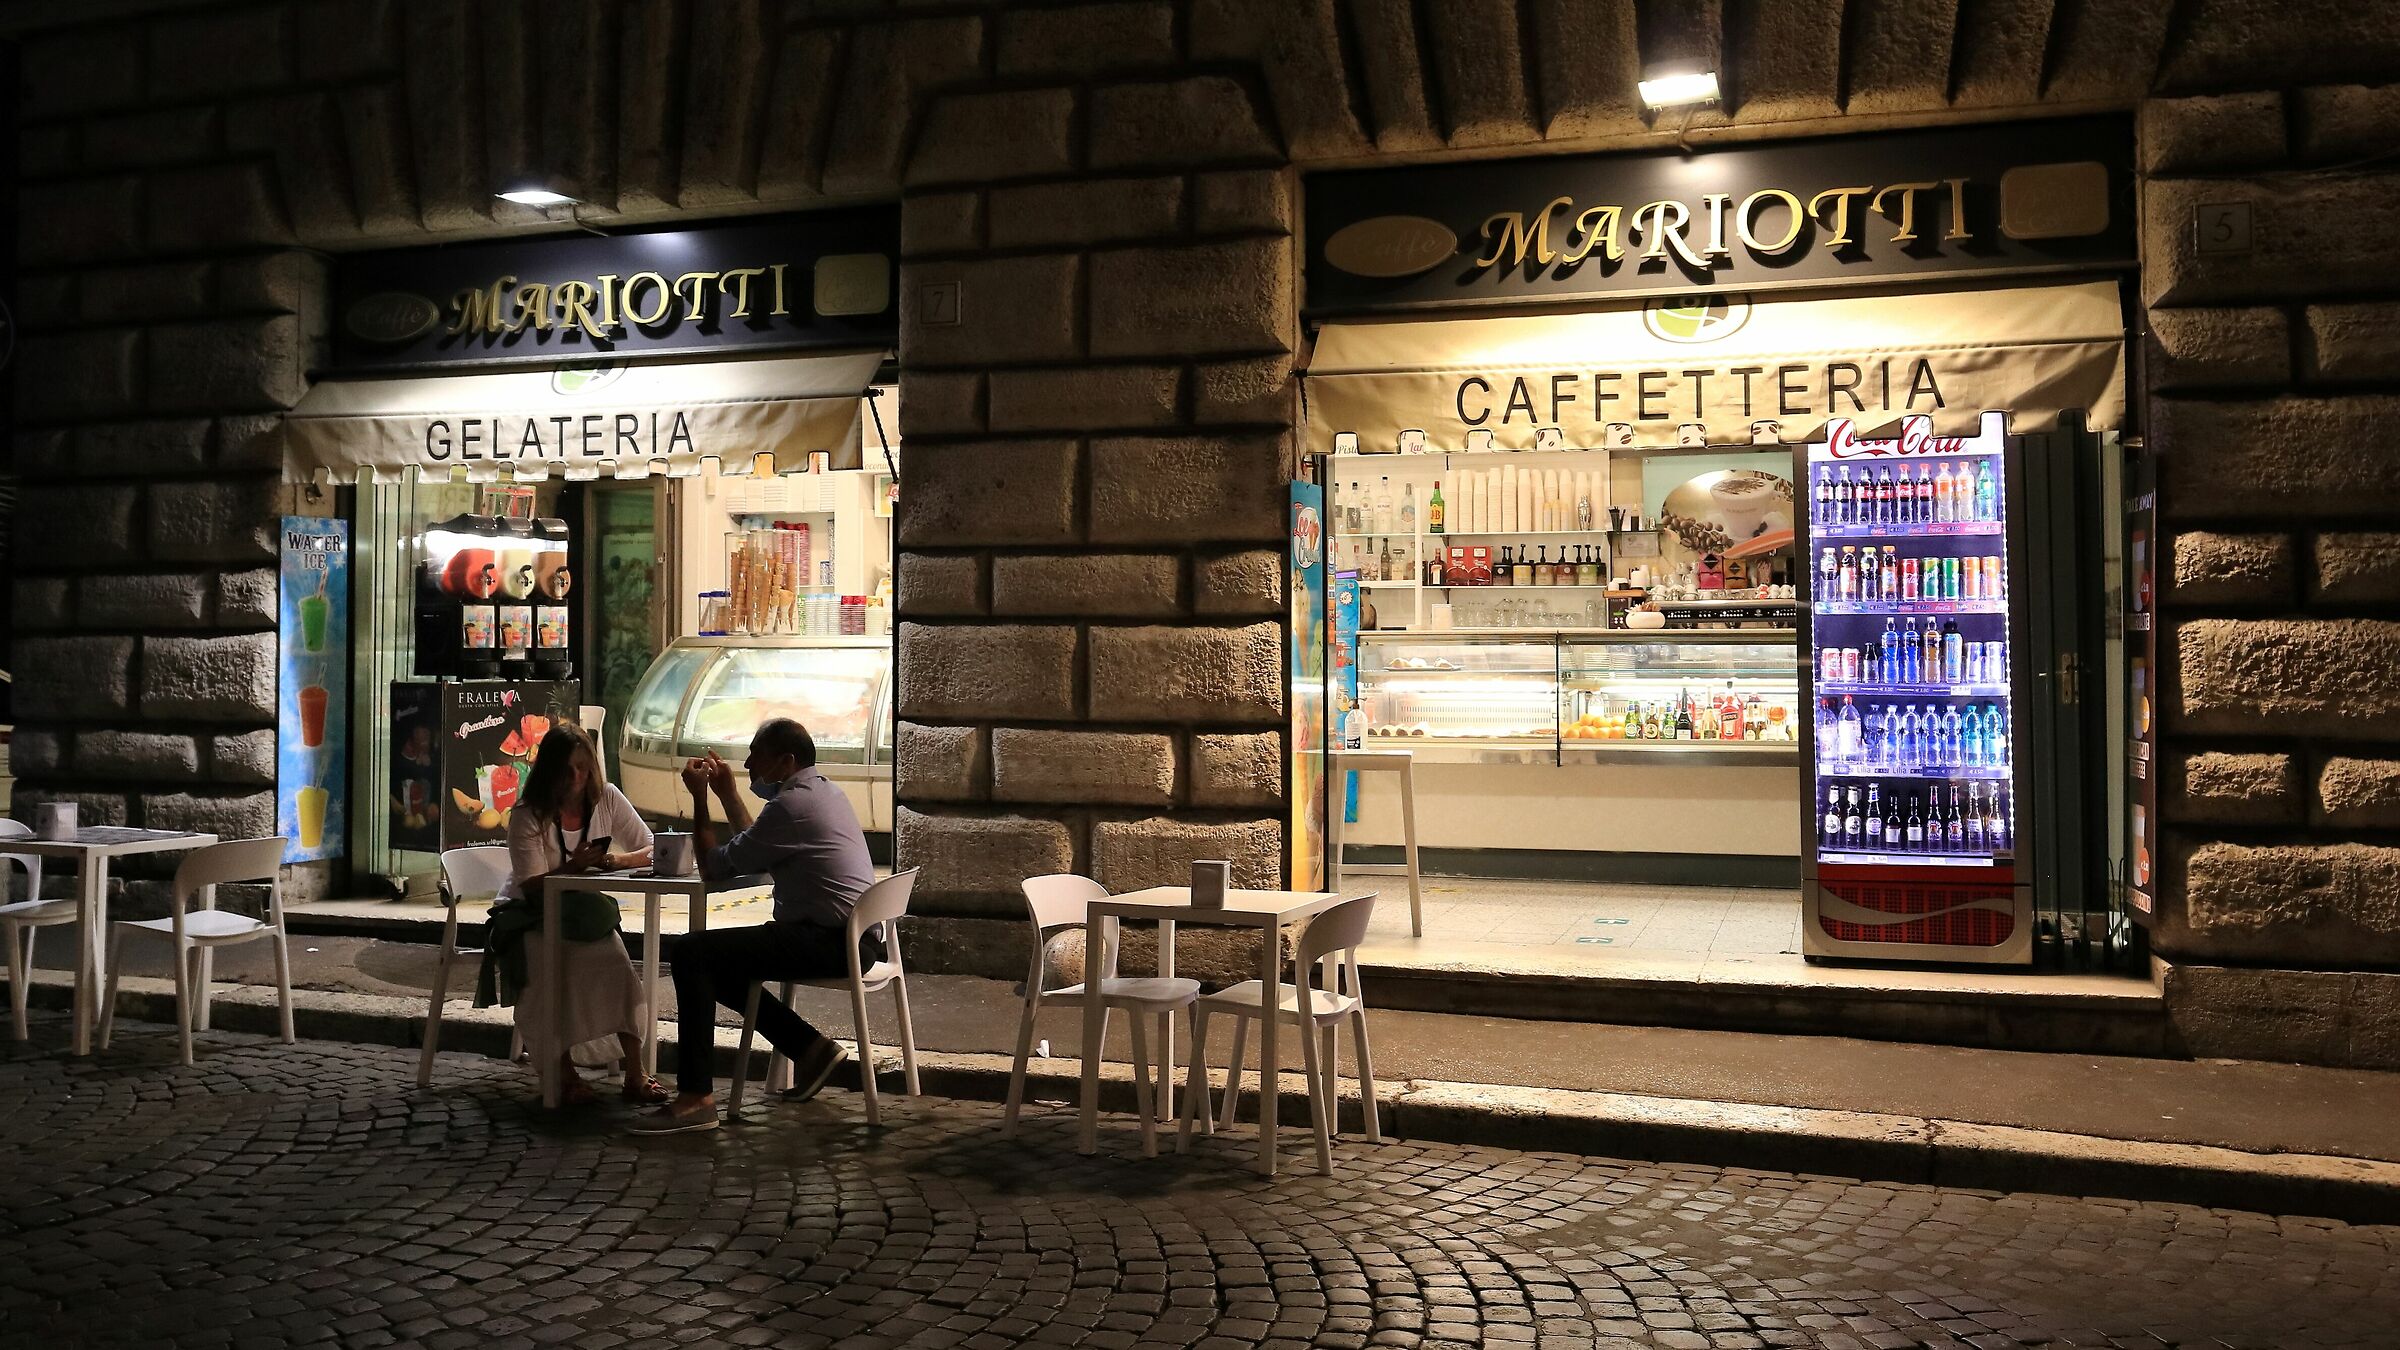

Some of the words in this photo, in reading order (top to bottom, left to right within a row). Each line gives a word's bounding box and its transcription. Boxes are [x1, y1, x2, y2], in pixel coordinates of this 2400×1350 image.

[1476, 177, 1974, 269] MARIOTTI
[2213, 211, 2233, 243] 5
[447, 263, 790, 339] MARIOTTI
[932, 291, 945, 317] 7
[1455, 358, 1947, 427] CAFFETTERIA
[425, 411, 695, 461] GELATERIA
[1830, 415, 1968, 458] CocaCola
[287, 530, 342, 552] WATER
[304, 552, 327, 570] ICE
